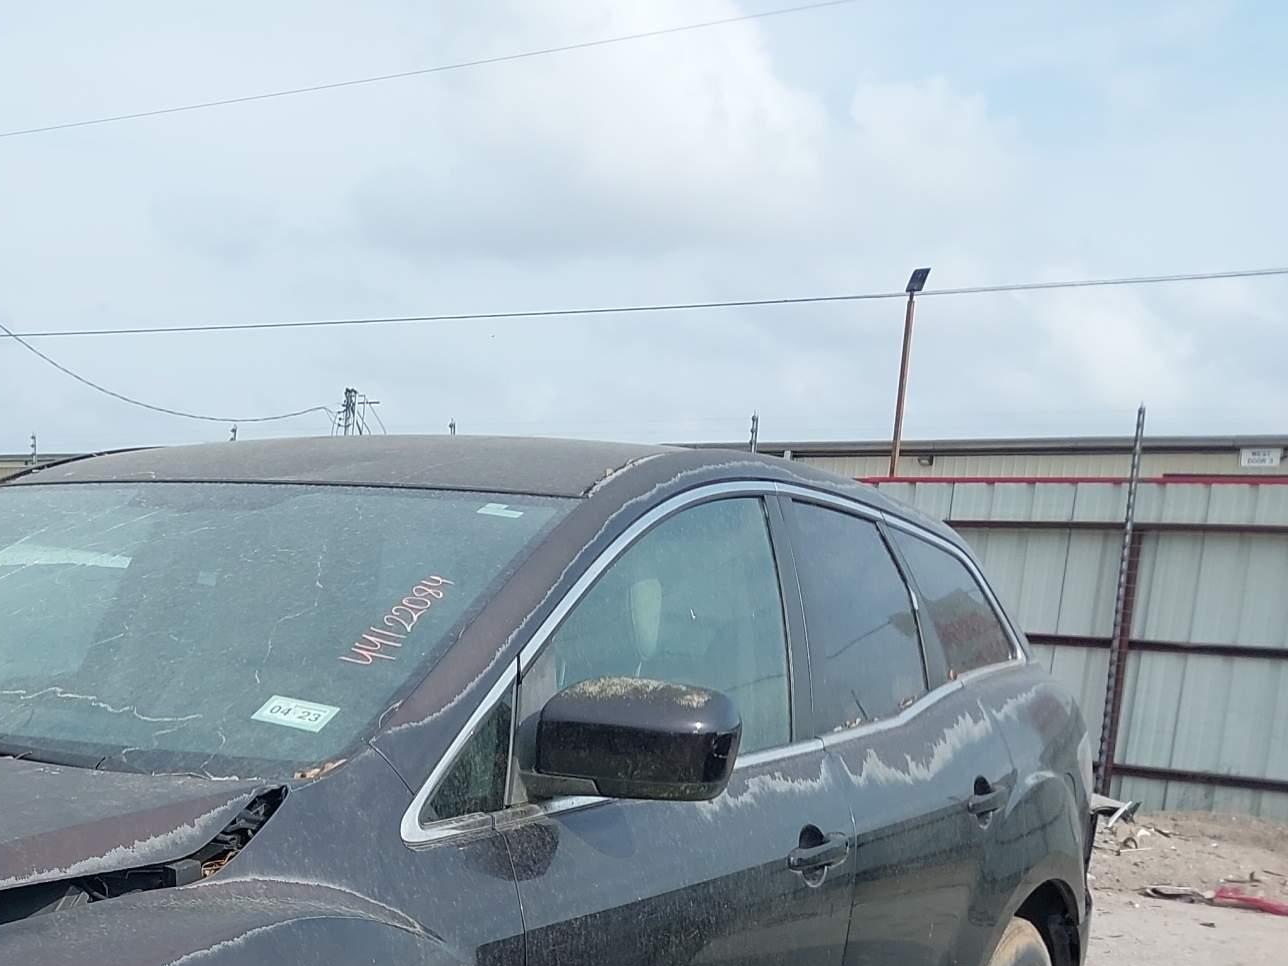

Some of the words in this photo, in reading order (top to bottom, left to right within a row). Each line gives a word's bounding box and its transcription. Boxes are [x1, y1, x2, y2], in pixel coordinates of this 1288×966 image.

[338, 575, 454, 665] 44122084
[270, 705, 292, 716] 04
[296, 711, 321, 722] 23
